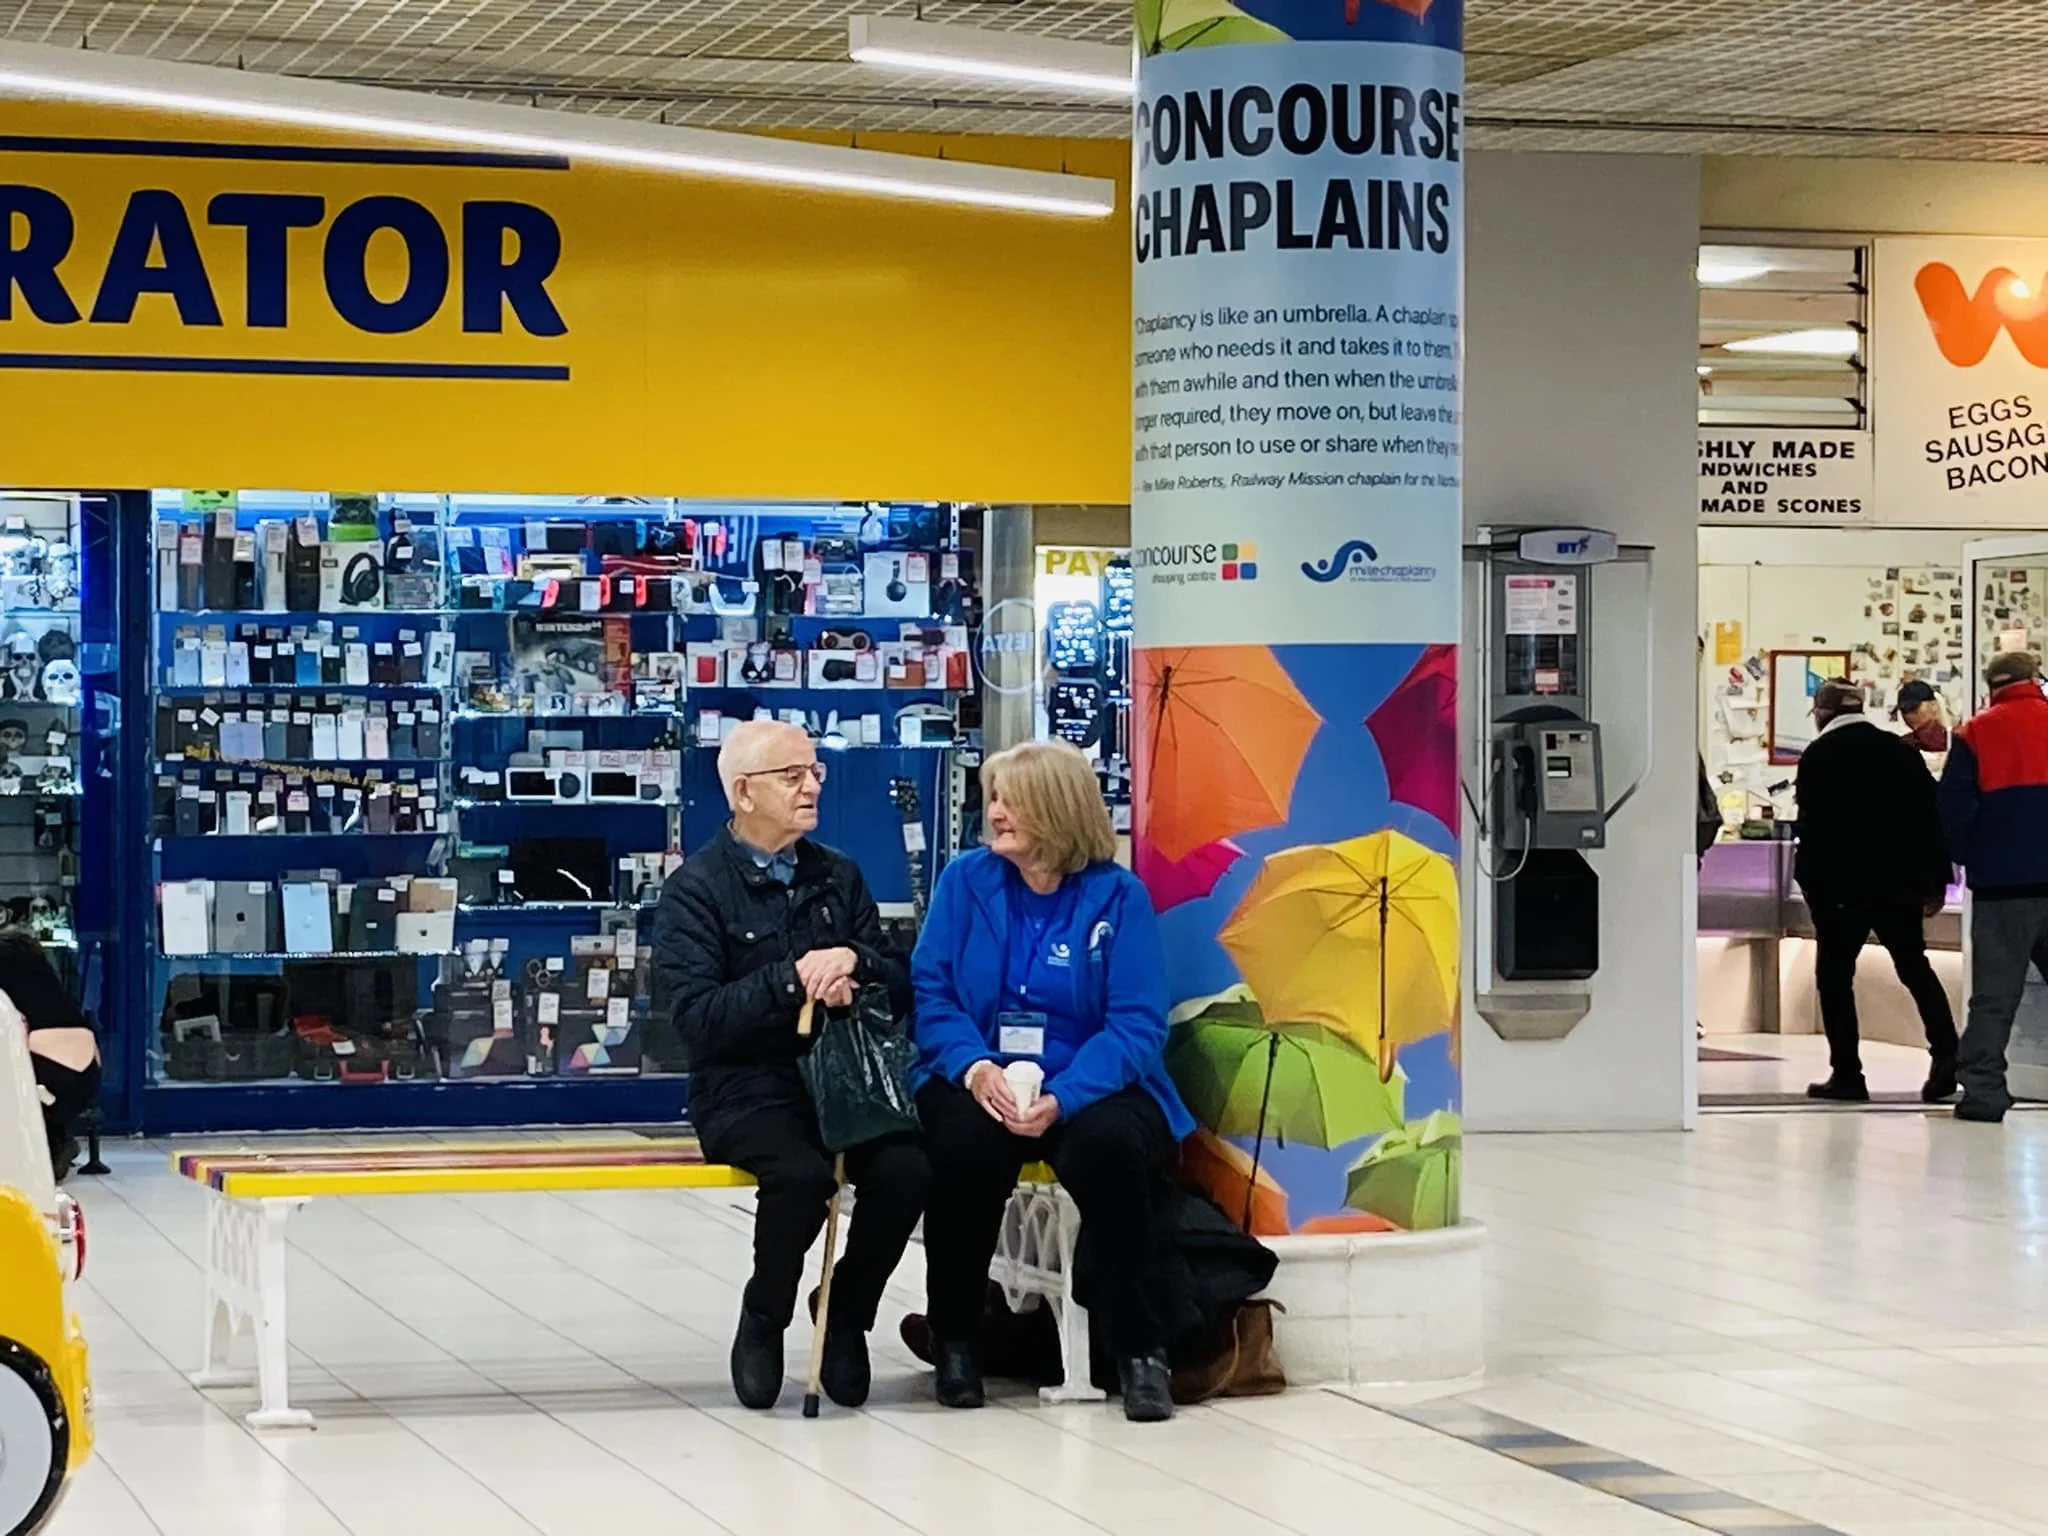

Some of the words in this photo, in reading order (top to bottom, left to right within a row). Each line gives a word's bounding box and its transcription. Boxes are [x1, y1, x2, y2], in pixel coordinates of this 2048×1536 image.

[1137, 83, 1459, 169] CONCOURSE
[1136, 178, 1450, 263] CHAPLAINS
[0, 184, 569, 337] RATOR
[1200, 309, 1214, 326] is
[1218, 307, 1249, 325] like
[1253, 308, 1277, 324] an
[1283, 304, 1371, 324] umbrella.
[1376, 304, 1389, 323] A
[1180, 342, 1213, 360] who
[1217, 338, 1275, 357] needs
[1280, 337, 1292, 355] it
[1298, 336, 1335, 356] and
[1340, 336, 1389, 356] takes
[1393, 339, 1403, 357] it
[1406, 339, 1421, 357] to
[1184, 372, 1237, 392] awhile
[1242, 370, 1278, 389] and
[1284, 369, 1329, 388] then
[1335, 369, 1385, 388] when
[1389, 370, 1414, 389] the
[1160, 404, 1225, 429] required,
[1230, 403, 1271, 425] they
[1277, 405, 1331, 421] move
[1337, 405, 1364, 423] on,
[1369, 401, 1398, 421] but
[1401, 402, 1436, 422] leave
[1948, 395, 2032, 429] EGGS
[1175, 440, 1231, 461] person
[1236, 438, 1255, 454] to
[1260, 438, 1295, 454] use
[1300, 438, 1321, 453] or
[1325, 433, 1378, 453] share
[1382, 434, 1424, 453] when
[1772, 441, 1855, 459] MADE
[1925, 423, 2048, 463] SAUSAG
[1231, 472, 1285, 489] Railway
[1288, 471, 1344, 486] Mission
[1347, 471, 1401, 487] chaplain
[1701, 462, 1817, 477] NDWICHES
[1946, 452, 2048, 490] BACON
[1721, 481, 1768, 494] AND
[1701, 499, 1765, 513] MADE
[1777, 498, 1862, 513] SCONES
[1045, 550, 1115, 576] PAY
